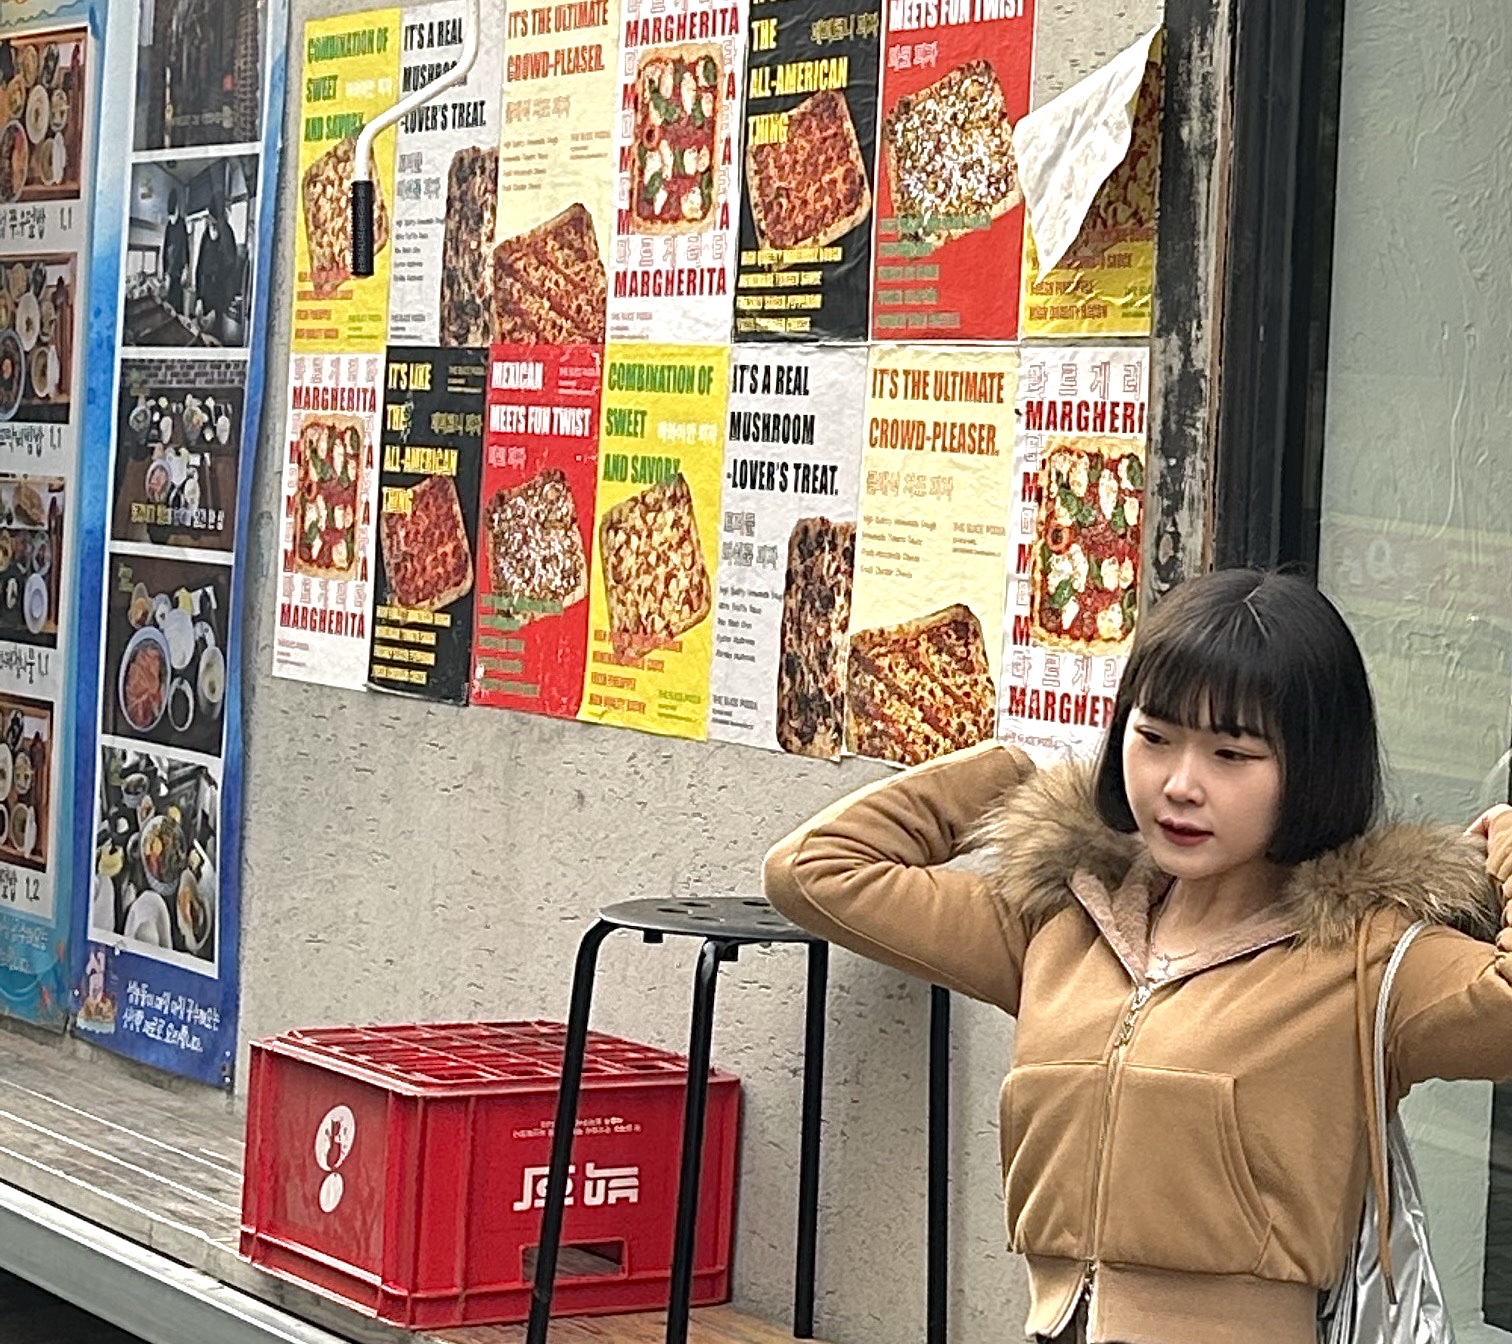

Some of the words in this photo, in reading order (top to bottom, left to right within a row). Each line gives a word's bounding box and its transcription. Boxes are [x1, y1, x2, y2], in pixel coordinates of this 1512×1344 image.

[531, 4, 551, 34] THE
[625, 5, 740, 48] MARGHERITA
[752, 18, 777, 52] THE
[614, 266, 727, 298] MARGHERITA
[698, 366, 714, 396] OF
[732, 364, 760, 395] IT'S
[761, 365, 772, 395] A
[775, 366, 810, 396] REAL
[871, 369, 900, 399] IT'S
[902, 370, 931, 401] THE
[933, 370, 1005, 404] ULTIMATE
[605, 408, 646, 438] SWEET
[729, 411, 815, 446] MUSHROOM
[869, 417, 1000, 456] CROWD-PLEASER.
[603, 453, 628, 483] AND
[793, 463, 839, 496] TREAT.
